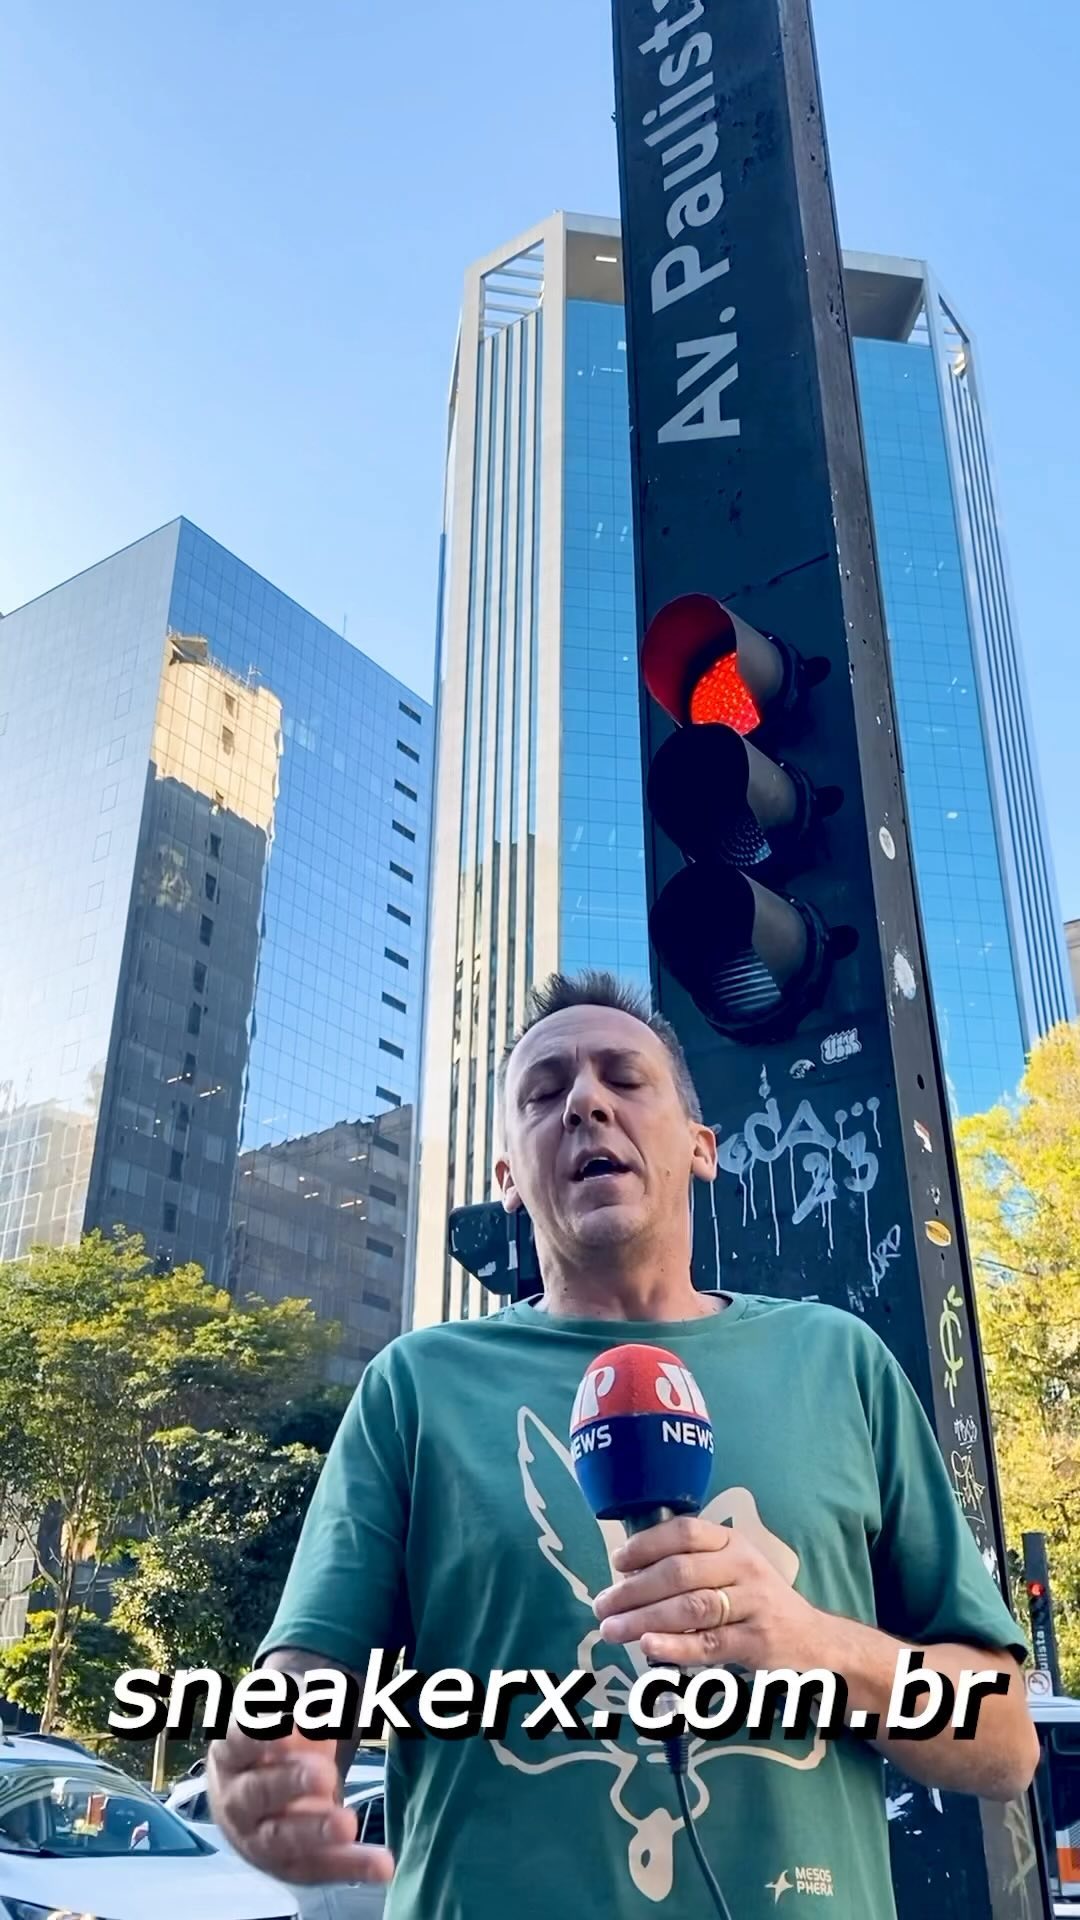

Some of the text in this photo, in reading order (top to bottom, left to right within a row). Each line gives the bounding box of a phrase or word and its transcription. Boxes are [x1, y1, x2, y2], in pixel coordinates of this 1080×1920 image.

[637, 0, 741, 444] Av. Paulist
[570, 1424, 612, 1462] EWS
[662, 1420, 715, 1455] NEWS
[795, 1866, 832, 1882] MESOS
[796, 1881, 834, 1897] PHERA
